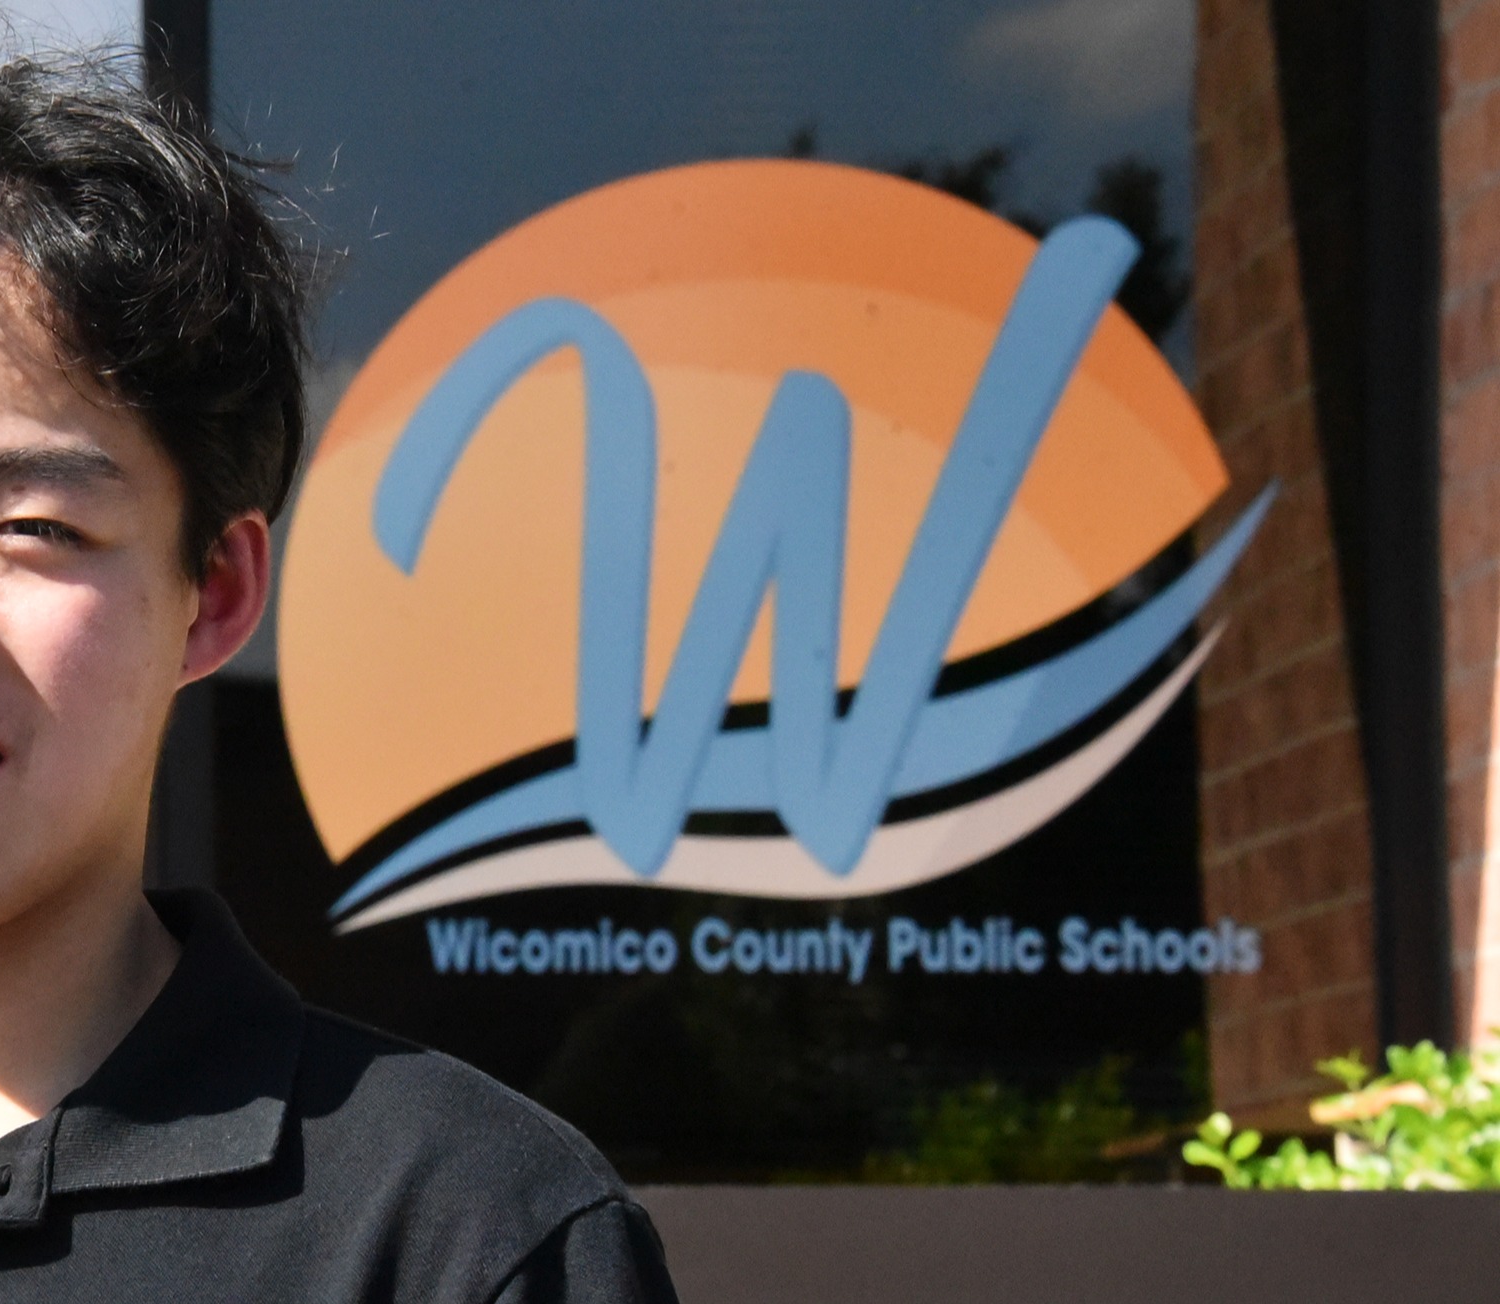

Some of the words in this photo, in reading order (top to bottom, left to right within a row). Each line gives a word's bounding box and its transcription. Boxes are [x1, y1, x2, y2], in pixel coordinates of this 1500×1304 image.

[372, 215, 1140, 878] W
[426, 915, 678, 975] Wicomico
[692, 915, 873, 986] County
[887, 914, 1045, 974] Public
[1058, 914, 1263, 975] Schools
